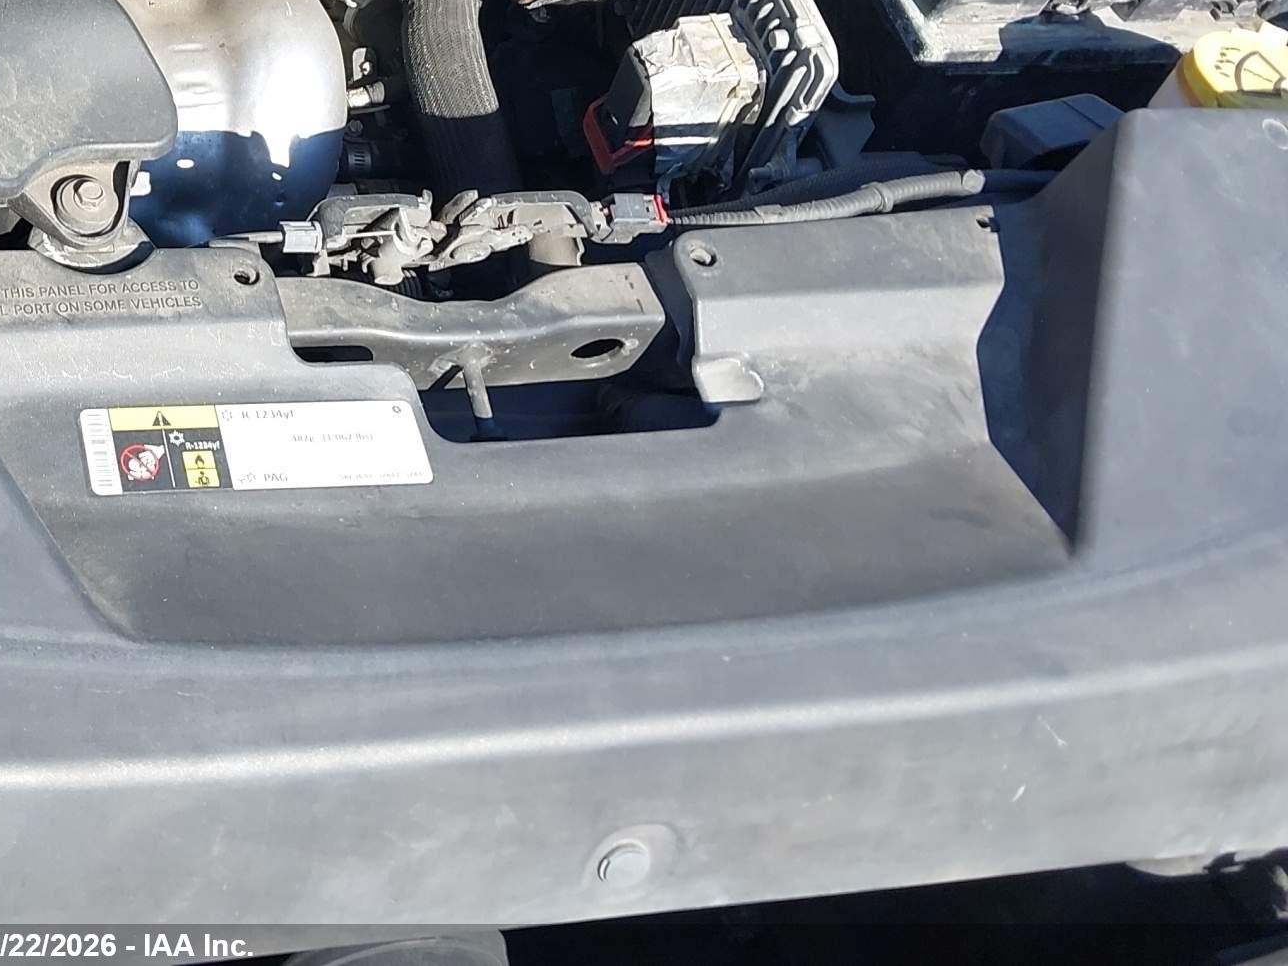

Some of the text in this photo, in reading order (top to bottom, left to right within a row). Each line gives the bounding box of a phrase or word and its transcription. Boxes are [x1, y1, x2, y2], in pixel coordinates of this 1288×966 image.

[2, 286, 35, 299] THIS
[39, 284, 85, 298] PANEL
[89, 283, 117, 295] FOR
[122, 281, 177, 294] ACCESS
[182, 280, 199, 291] TO
[14, 302, 51, 315] PORT
[55, 301, 80, 314] ON
[83, 299, 127, 312] SOME
[130, 296, 202, 310] VEHICLES
